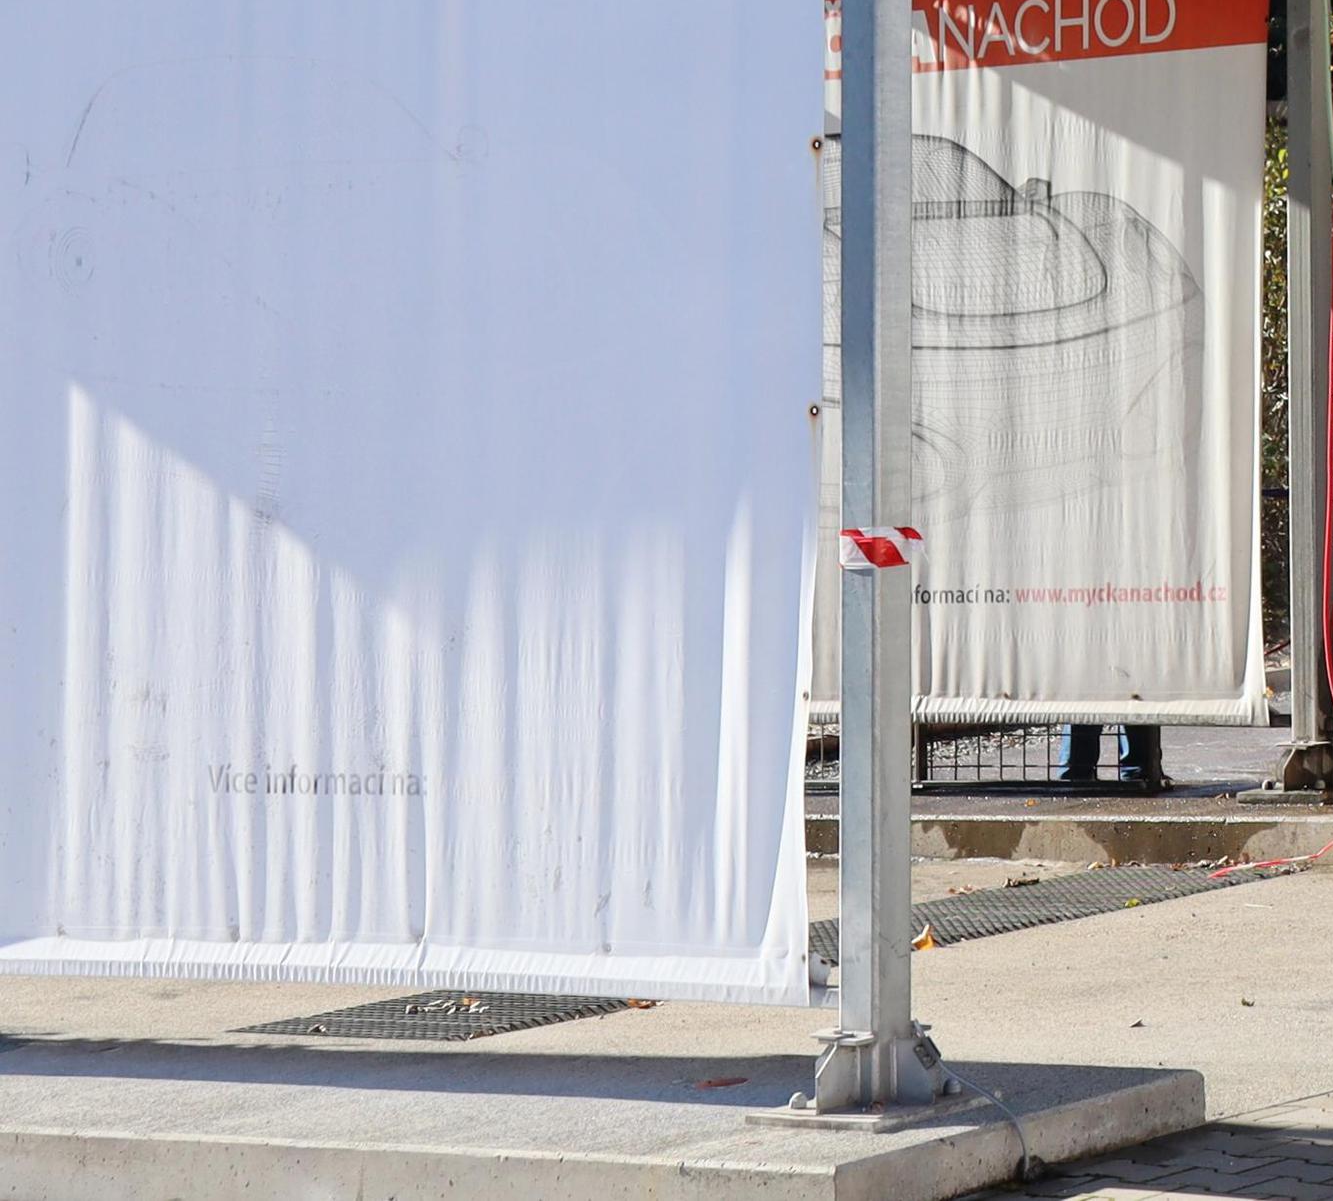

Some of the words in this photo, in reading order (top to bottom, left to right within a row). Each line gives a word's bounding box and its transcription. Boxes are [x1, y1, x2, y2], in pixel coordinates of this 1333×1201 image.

[912, 583, 979, 604] formací
[984, 588, 1010, 604] na:
[1015, 580, 1226, 607] www.myckanachod.cz
[208, 764, 258, 794] Více
[265, 764, 386, 796] informací
[391, 773, 428, 796] na:
